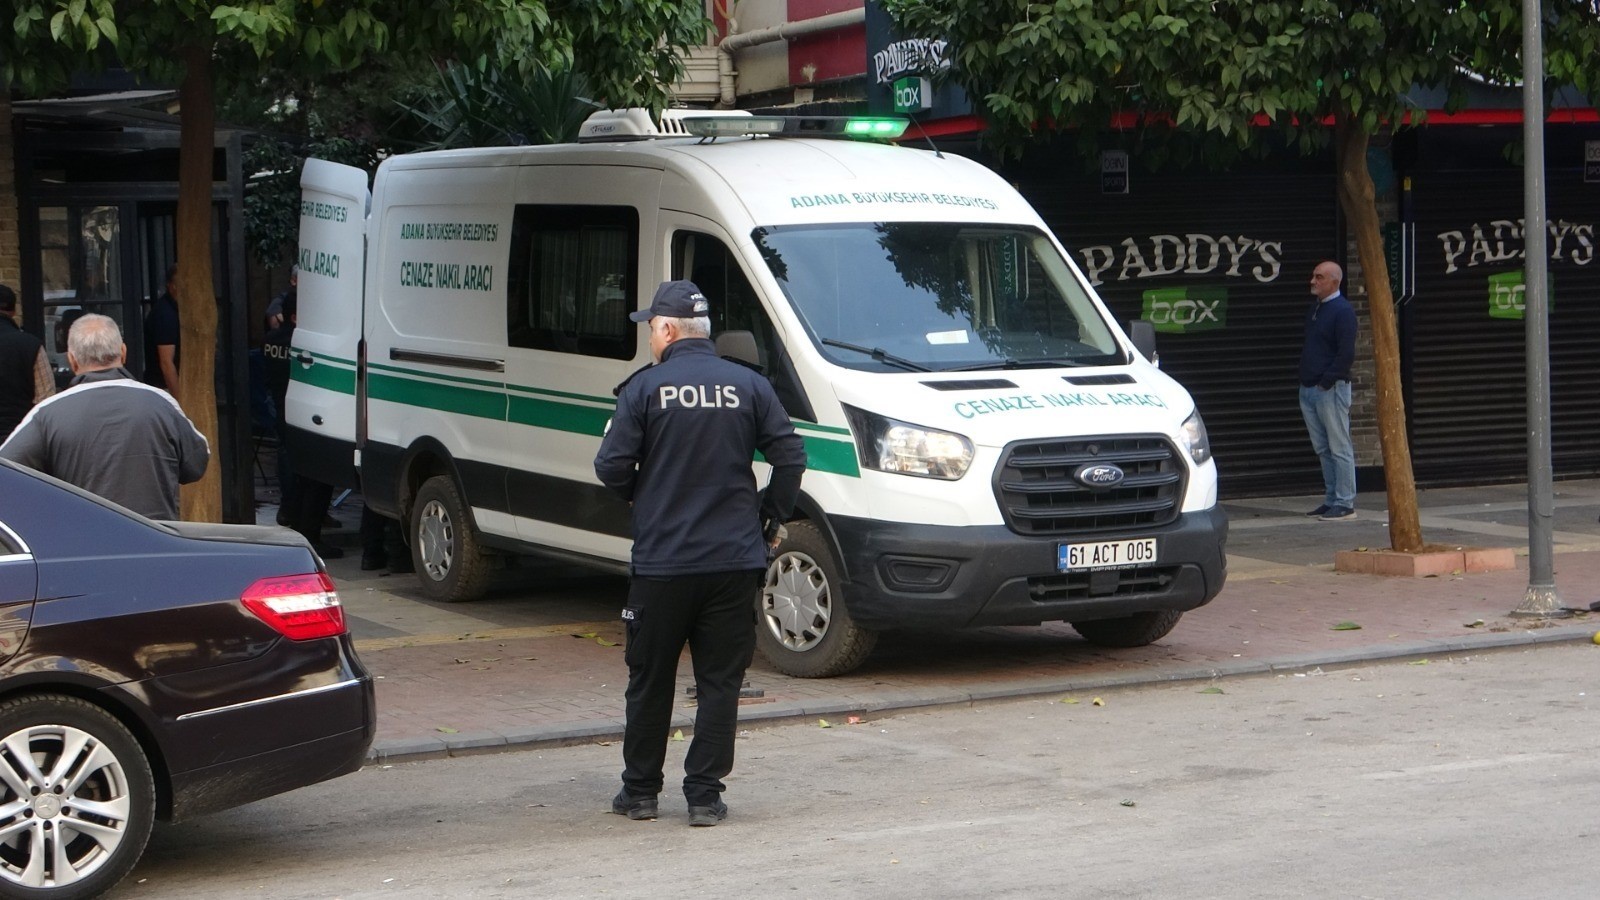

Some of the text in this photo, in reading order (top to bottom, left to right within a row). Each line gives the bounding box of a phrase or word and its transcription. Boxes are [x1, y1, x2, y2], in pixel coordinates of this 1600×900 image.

[896, 85, 919, 107] box
[790, 193, 851, 209] ADANA
[400, 223, 425, 240] ADANA
[1079, 233, 1283, 287] PADDY'S
[1437, 218, 1594, 275] PADY'S
[314, 252, 340, 279] ARACI
[400, 261, 434, 288] CENAZE
[463, 265, 493, 292] ARACI
[1150, 295, 1220, 324] box
[1496, 282, 1526, 310] bo
[954, 395, 1045, 419] CENAZE
[1112, 392, 1169, 410] ARACI
[1092, 468, 1116, 482] Ford
[1069, 541, 1153, 566] 61 ACT 005
